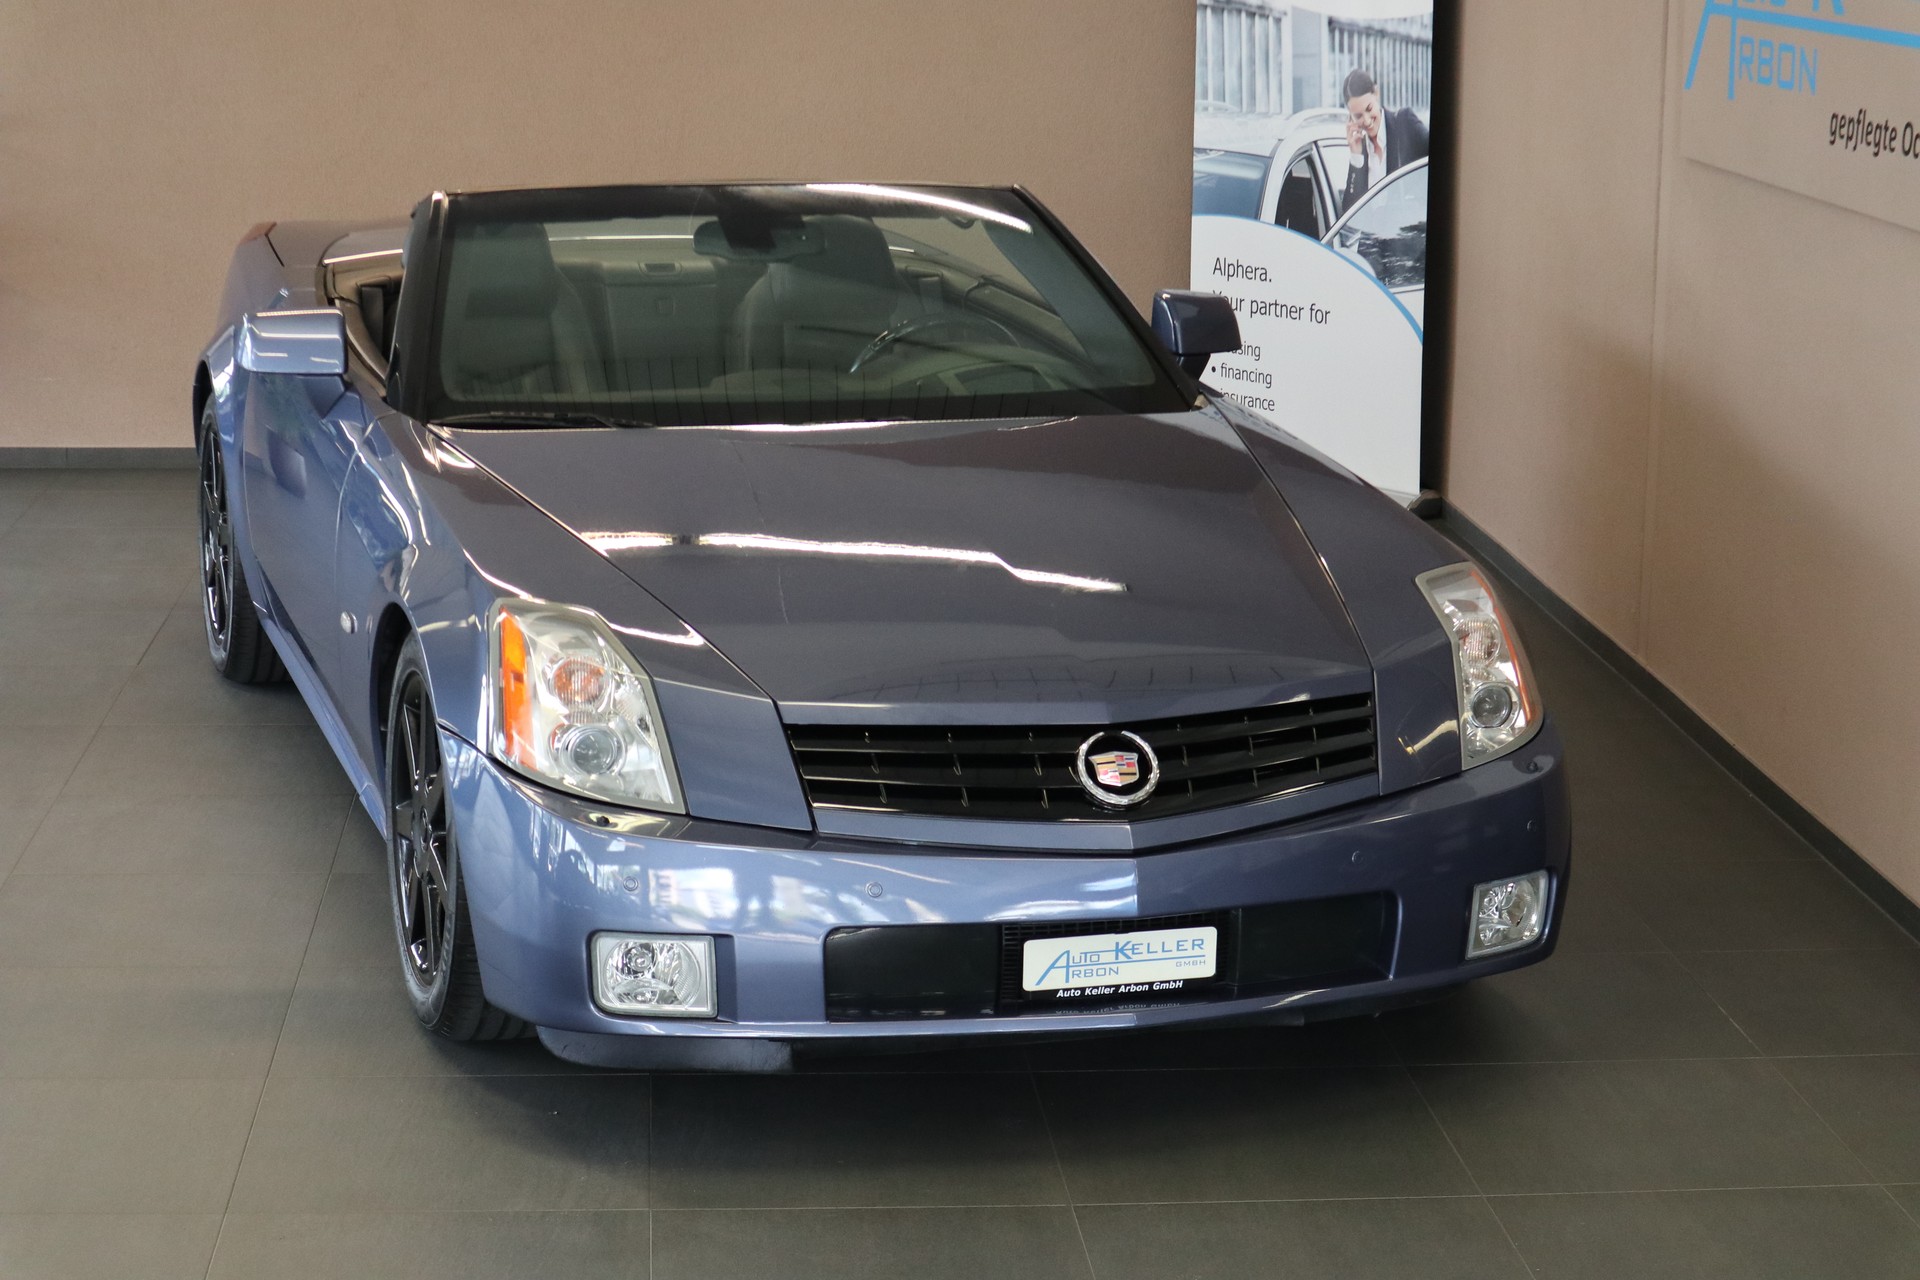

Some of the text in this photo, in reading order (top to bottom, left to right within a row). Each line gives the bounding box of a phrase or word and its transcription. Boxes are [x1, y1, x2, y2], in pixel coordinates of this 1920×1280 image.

[1829, 108, 1898, 158] gepflegte
[1212, 257, 1273, 283] Alphera.
[1212, 290, 1331, 324] ur partner for
[1231, 341, 1261, 361] sing
[1220, 362, 1272, 389] financing
[1114, 938, 1205, 961] KELLER
[1175, 959, 1206, 968] GMBH
[1056, 980, 1184, 998] Auto Keller Arbon GmbH
